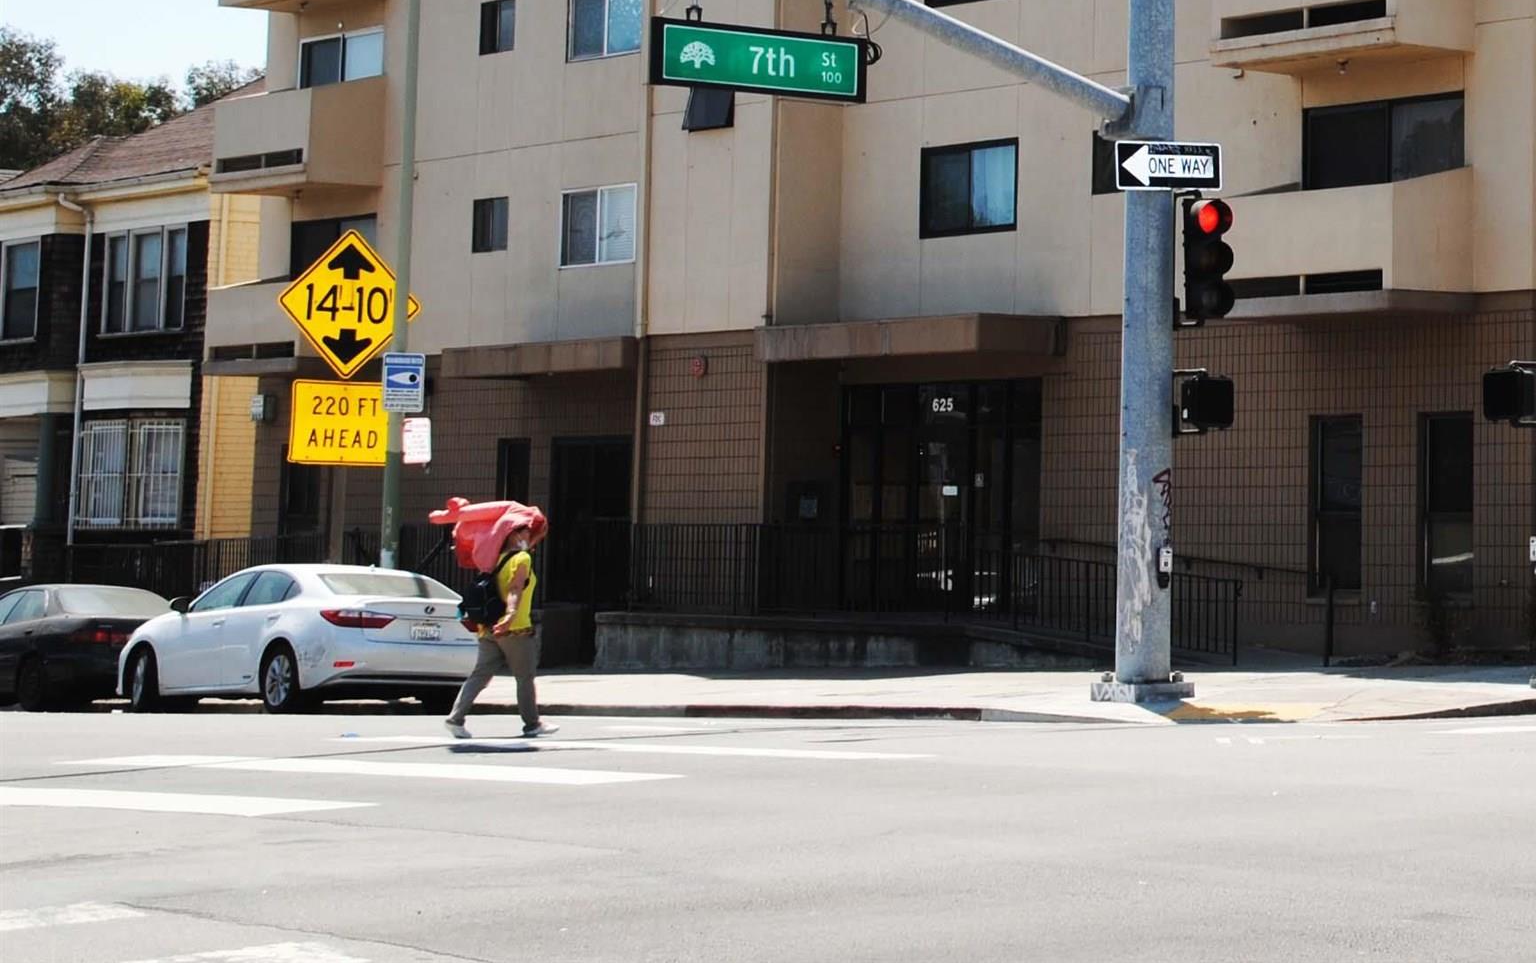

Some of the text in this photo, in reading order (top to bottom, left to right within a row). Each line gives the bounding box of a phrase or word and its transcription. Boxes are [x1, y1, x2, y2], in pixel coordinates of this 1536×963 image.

[748, 46, 837, 78] 7th St
[821, 71, 842, 83] 100
[1148, 157, 1210, 175] ONE WAY
[312, 395, 349, 416] 220
[358, 397, 379, 417] FT
[932, 397, 953, 412] 625
[307, 427, 378, 449] AHEAD
